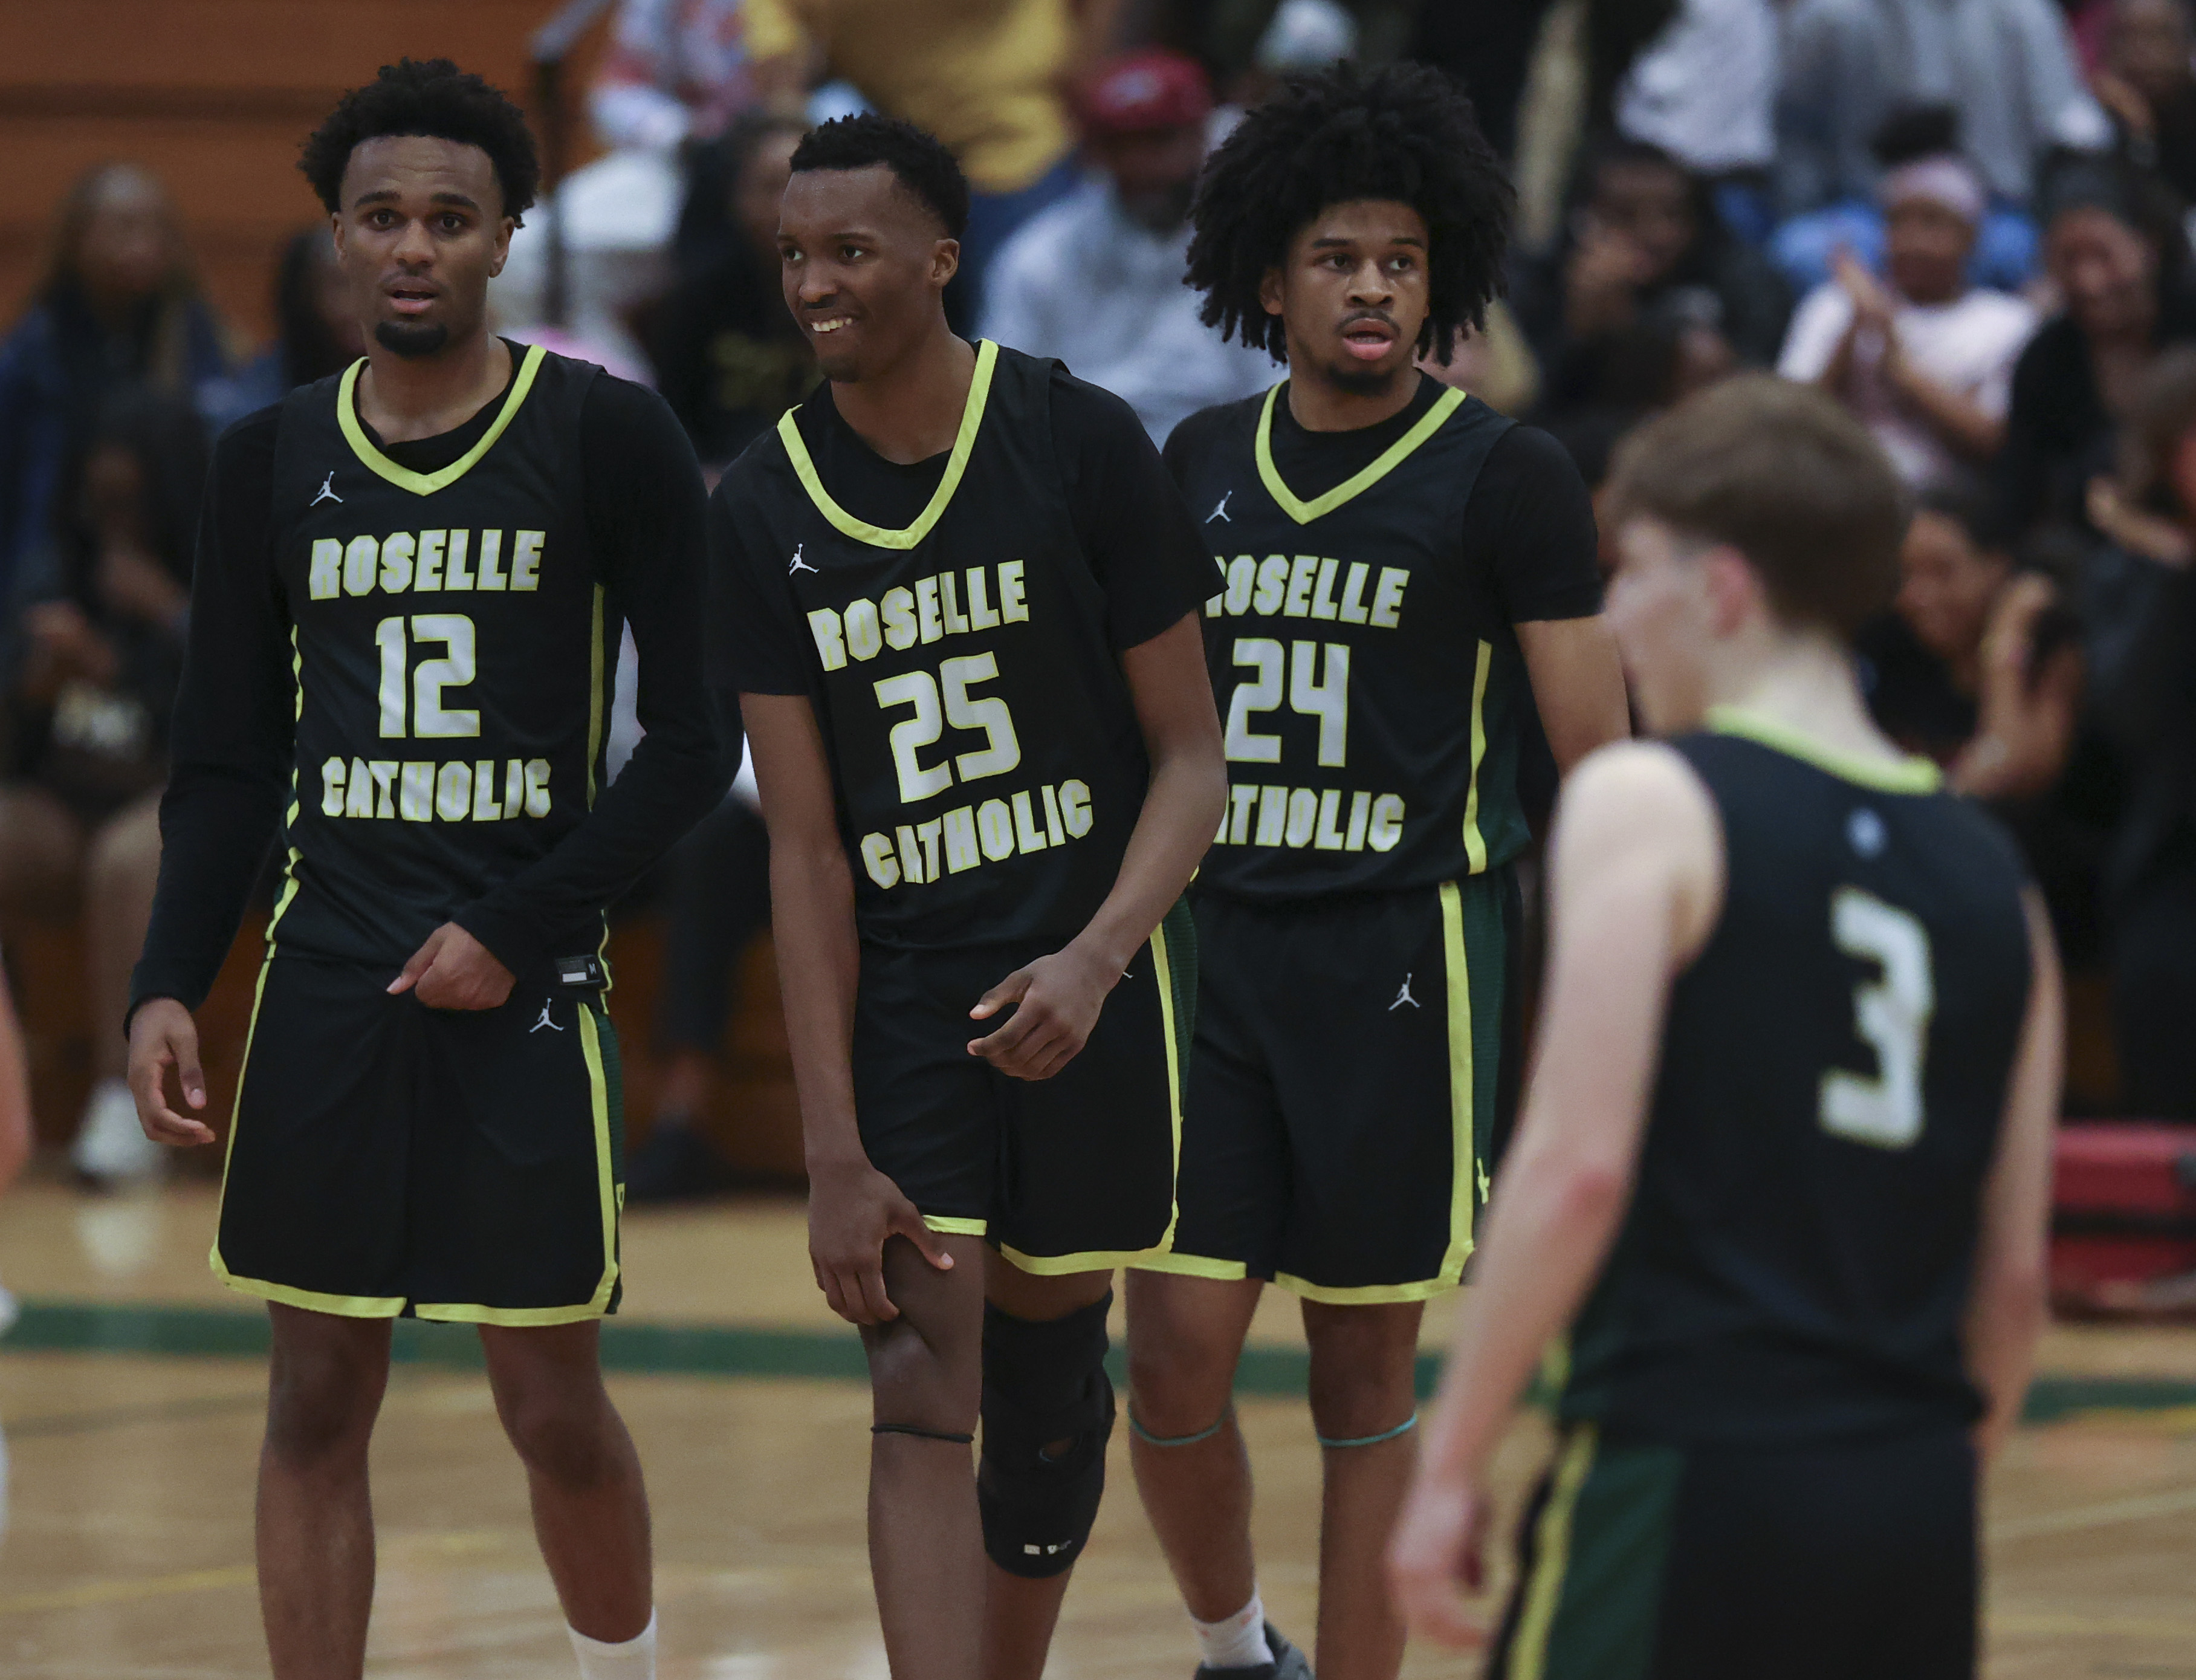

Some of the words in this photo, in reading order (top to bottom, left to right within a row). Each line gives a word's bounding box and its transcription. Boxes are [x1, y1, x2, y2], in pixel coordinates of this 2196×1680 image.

[309, 528, 546, 600] ROSELLE
[807, 559, 1029, 672] ROSELLE
[375, 613, 481, 739] 12
[873, 650, 1022, 804] 25
[1224, 637, 1351, 768] 24
[320, 756, 552, 822] CATHOLIC
[860, 779, 1093, 890] CATHOLIC
[1213, 783, 1406, 852] THOLIC
[1819, 885, 1935, 1149] 3
